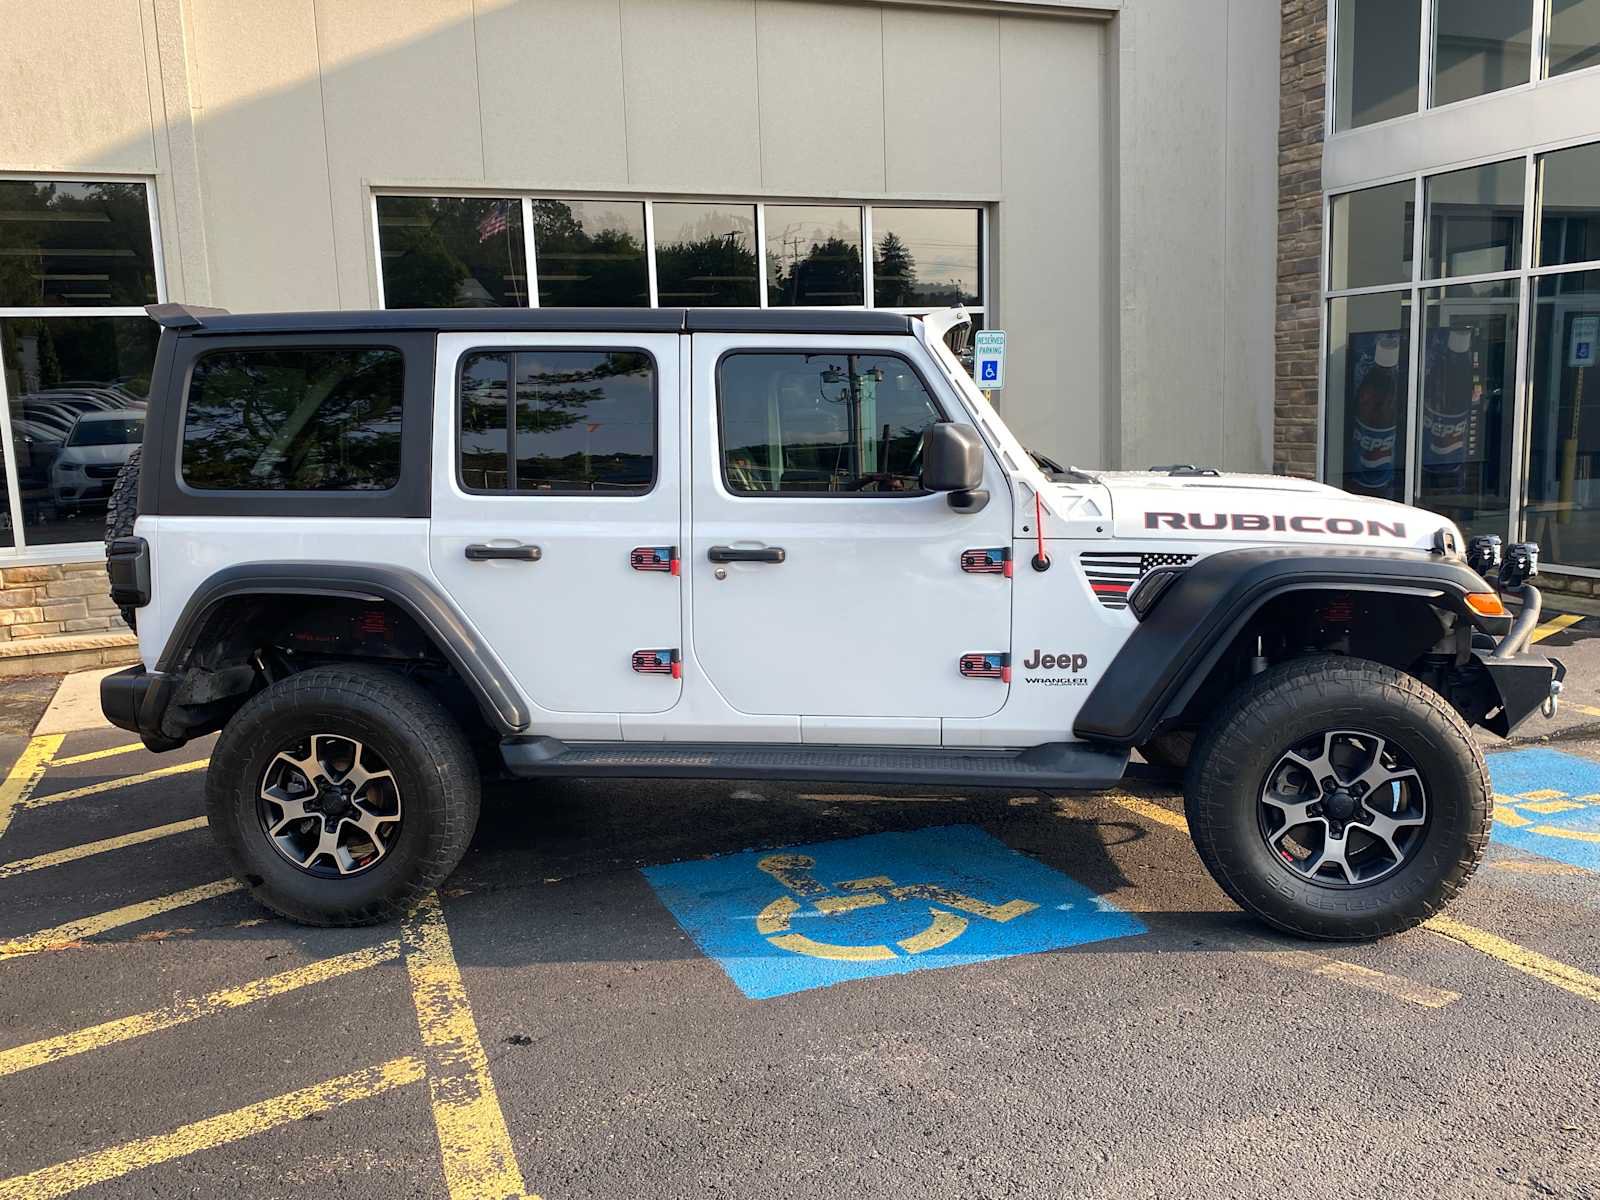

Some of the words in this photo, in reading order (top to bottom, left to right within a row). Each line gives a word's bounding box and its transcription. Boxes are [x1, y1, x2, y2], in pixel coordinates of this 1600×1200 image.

[977, 336, 1004, 345] RESERVED
[979, 346, 1002, 354] PARKING
[1144, 511, 1406, 538] RUBICON
[1024, 649, 1088, 673] Jeep
